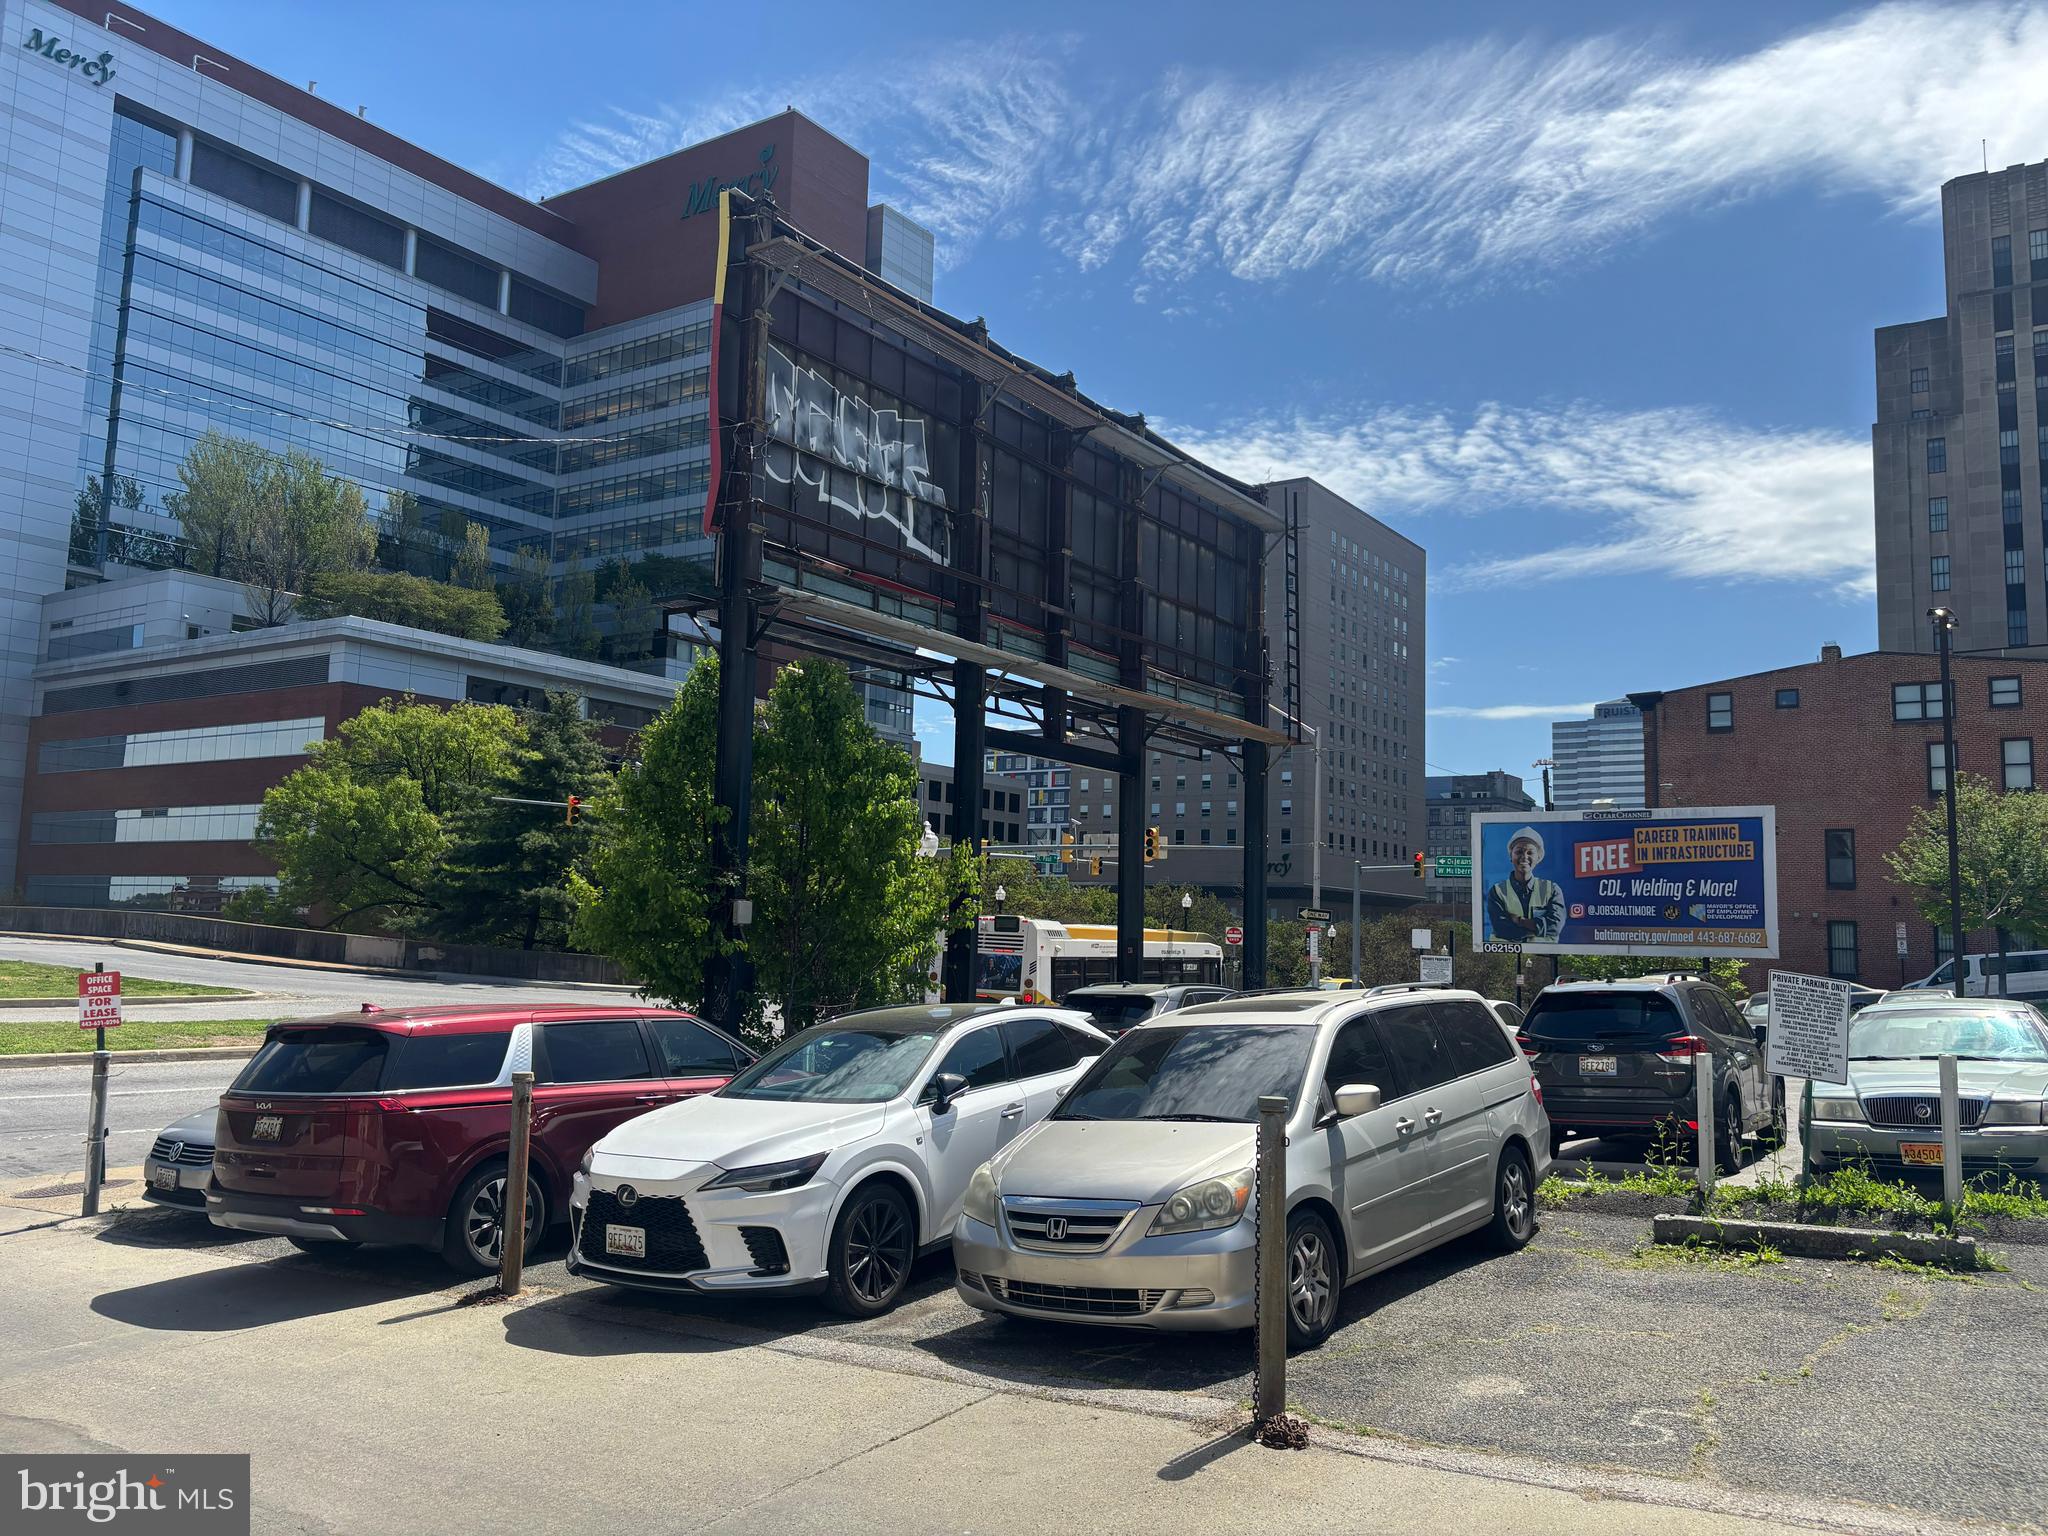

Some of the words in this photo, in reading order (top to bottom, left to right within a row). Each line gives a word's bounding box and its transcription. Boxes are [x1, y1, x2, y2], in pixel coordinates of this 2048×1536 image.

[23, 28, 117, 86] Mercy
[1596, 706, 1636, 717] TRUIST
[1637, 829, 1678, 844] CAREER
[1683, 826, 1736, 842] TRAINING
[1581, 843, 1630, 872] FREE
[1638, 847, 1648, 861] IN
[1652, 844, 1751, 860] INFRASTRUCTURE
[1600, 879, 1626, 898] CDL,
[1632, 878, 1682, 900] Welding
[1686, 880, 1696, 896] &
[1700, 880, 1738, 896] More!
[1588, 906, 1656, 916] @JOBSBALTIMORE
[1594, 929, 1694, 944] baltimorecity.gov/moed
[1697, 932, 1761, 944] 443-687-6682
[1484, 944, 1520, 952] 062150
[87, 976, 112, 984] OFFICE
[1772, 973, 1799, 985] PRIVATE
[1801, 978, 1828, 989] PARKING
[1830, 982, 1846, 992] ONLY
[88, 985, 112, 993] SPACE
[89, 998, 111, 1007] FOR
[84, 1008, 117, 1018] LEASE
